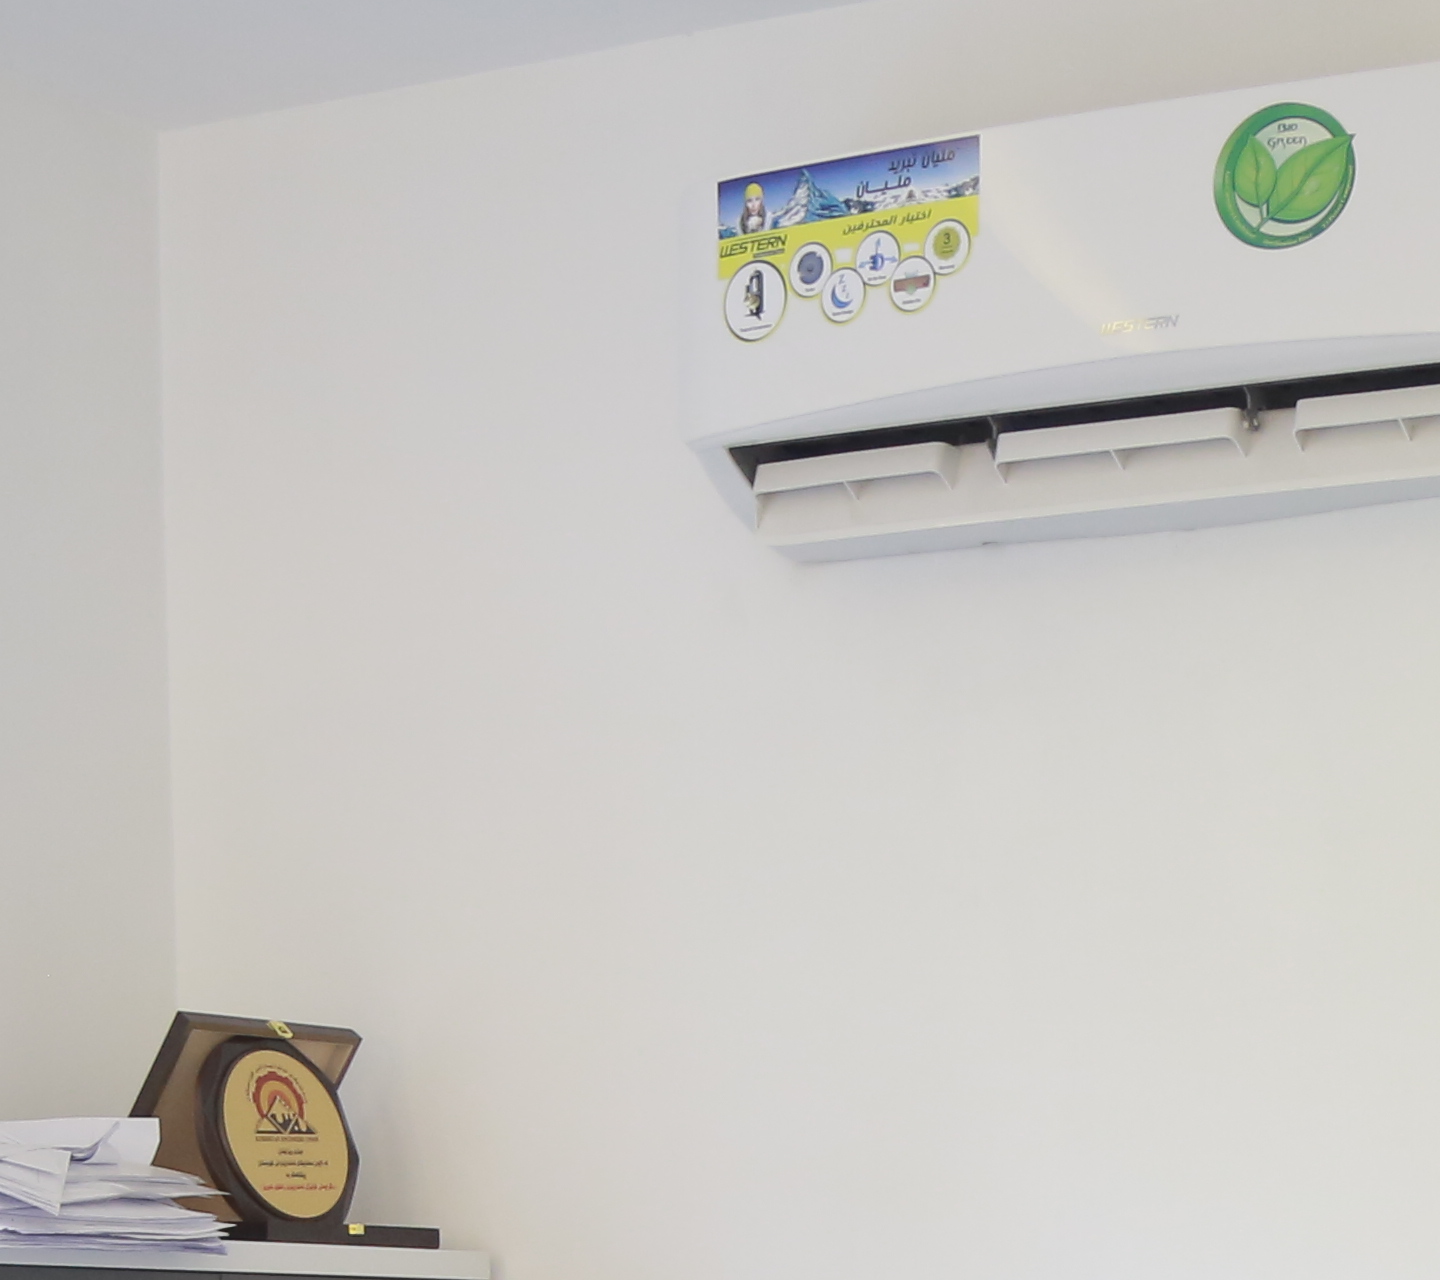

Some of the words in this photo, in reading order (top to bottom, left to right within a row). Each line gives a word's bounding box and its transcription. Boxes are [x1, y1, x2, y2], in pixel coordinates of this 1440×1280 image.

[842, 214, 898, 235] المحترفين
[898, 208, 932, 226] اختيار
[719, 233, 788, 259] WESTERN
[942, 232, 952, 245] 3
[1100, 313, 1180, 336] WESTERN
